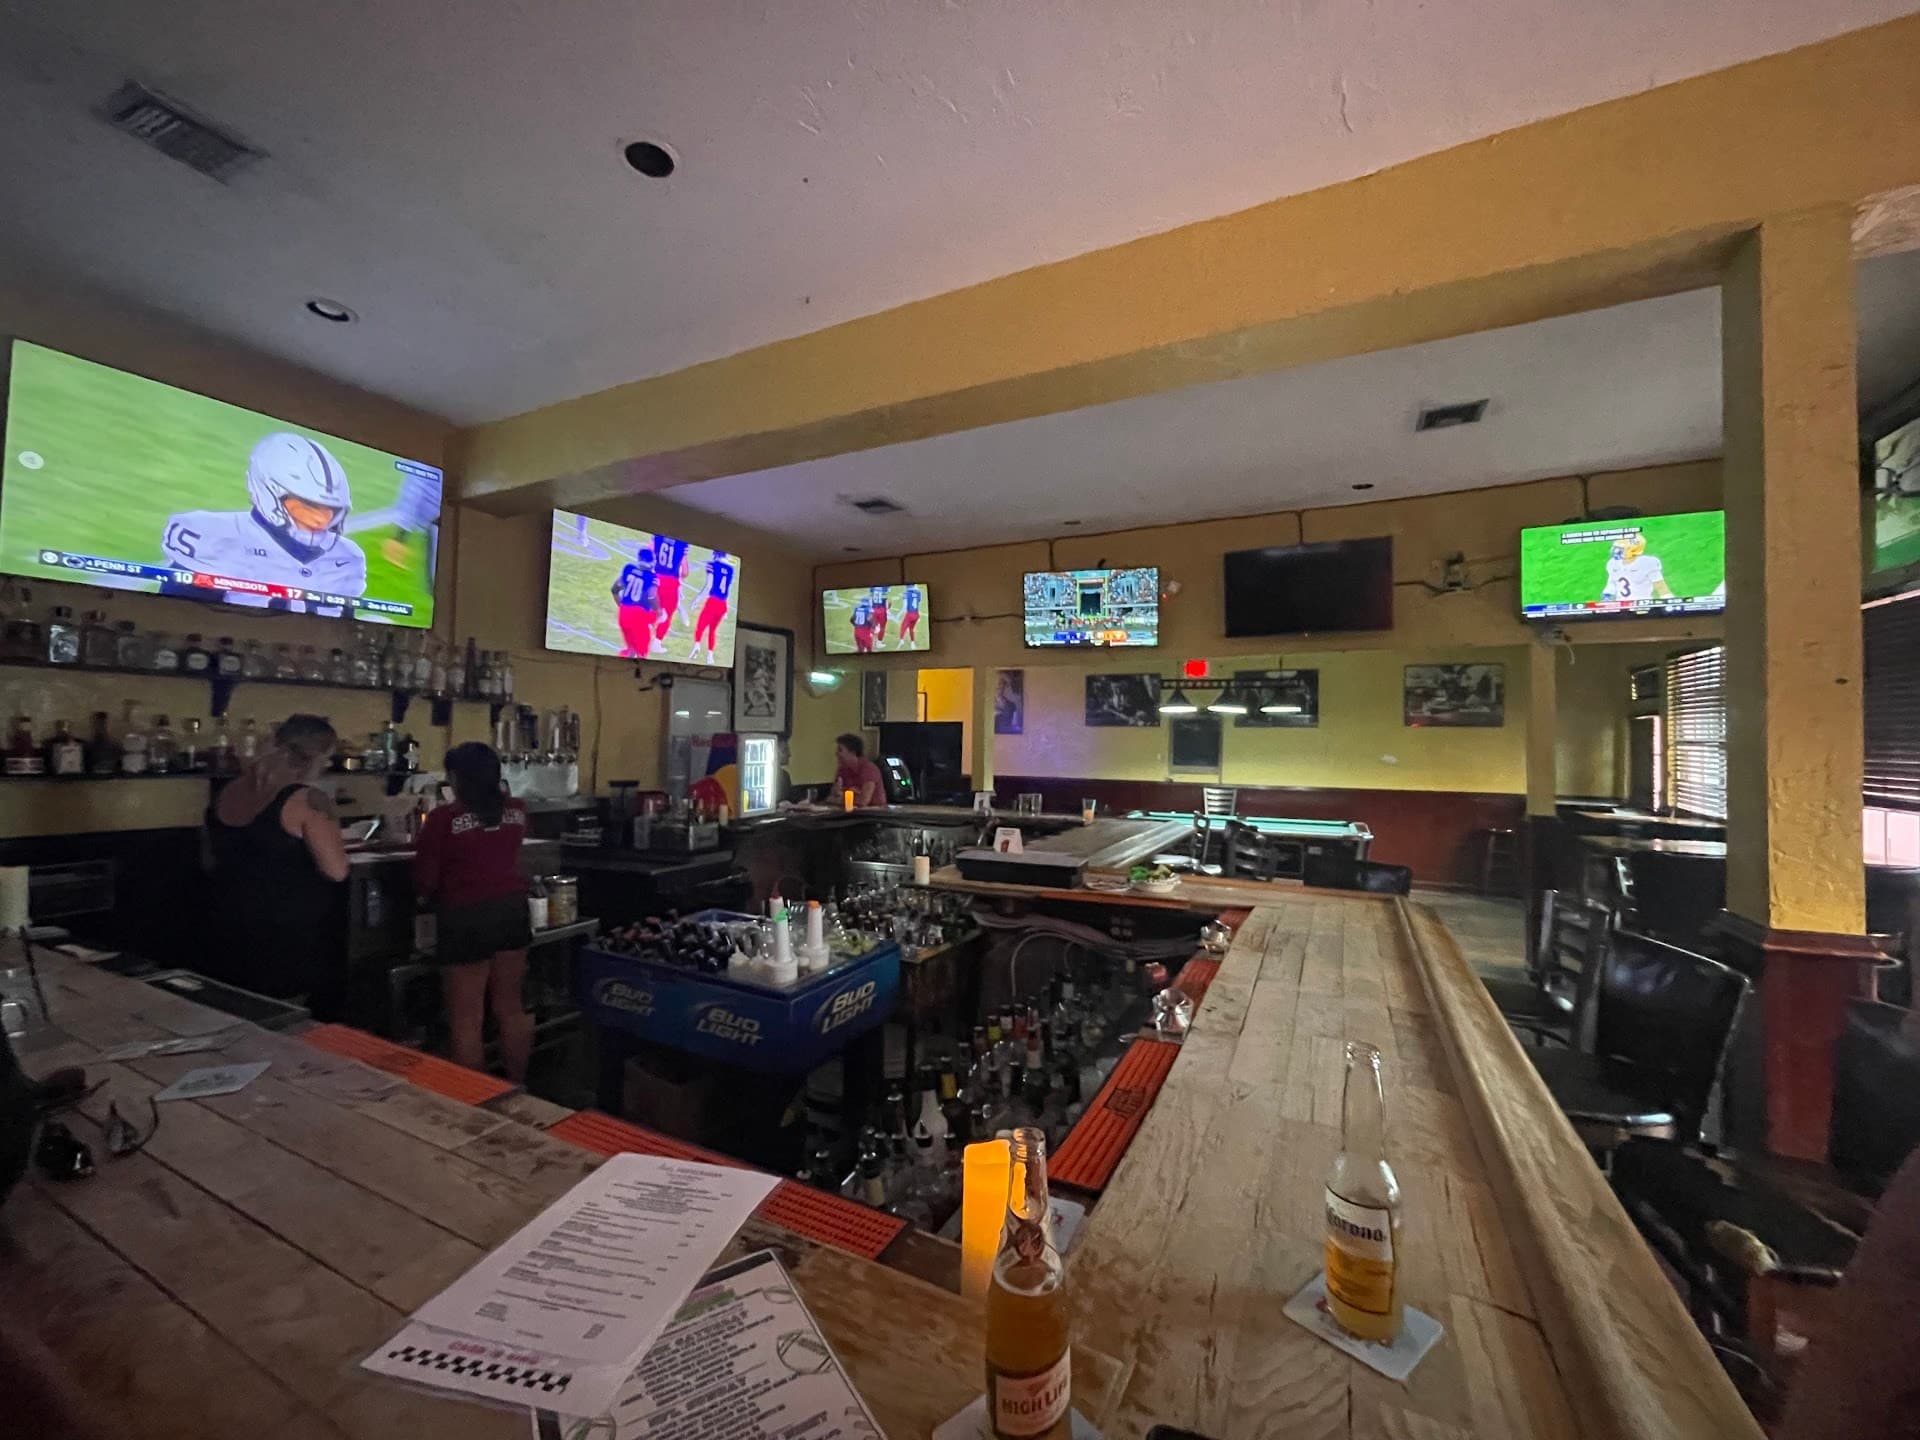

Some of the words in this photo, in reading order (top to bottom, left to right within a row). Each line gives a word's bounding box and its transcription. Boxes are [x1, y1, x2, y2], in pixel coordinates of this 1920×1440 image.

[165, 522, 201, 558] 15
[658, 542, 674, 569] 61
[94, 560, 126, 572] PENN
[127, 564, 143, 574] ST
[174, 572, 193, 584] 10
[214, 577, 269, 592] MINNESOTA
[286, 588, 303, 600] 17
[624, 574, 644, 602] 70
[719, 576, 727, 595] 4
[1617, 576, 1632, 598] 3
[602, 993, 656, 1017] LIGHT
[611, 982, 654, 1004] BUD
[832, 980, 876, 1014] BUD
[707, 1007, 760, 1033] BUD
[821, 992, 877, 1035] LIGHT
[696, 1018, 763, 1047] LIGHT
[1002, 1396, 1043, 1415] HIGH
[1045, 1376, 1067, 1406] LIF
